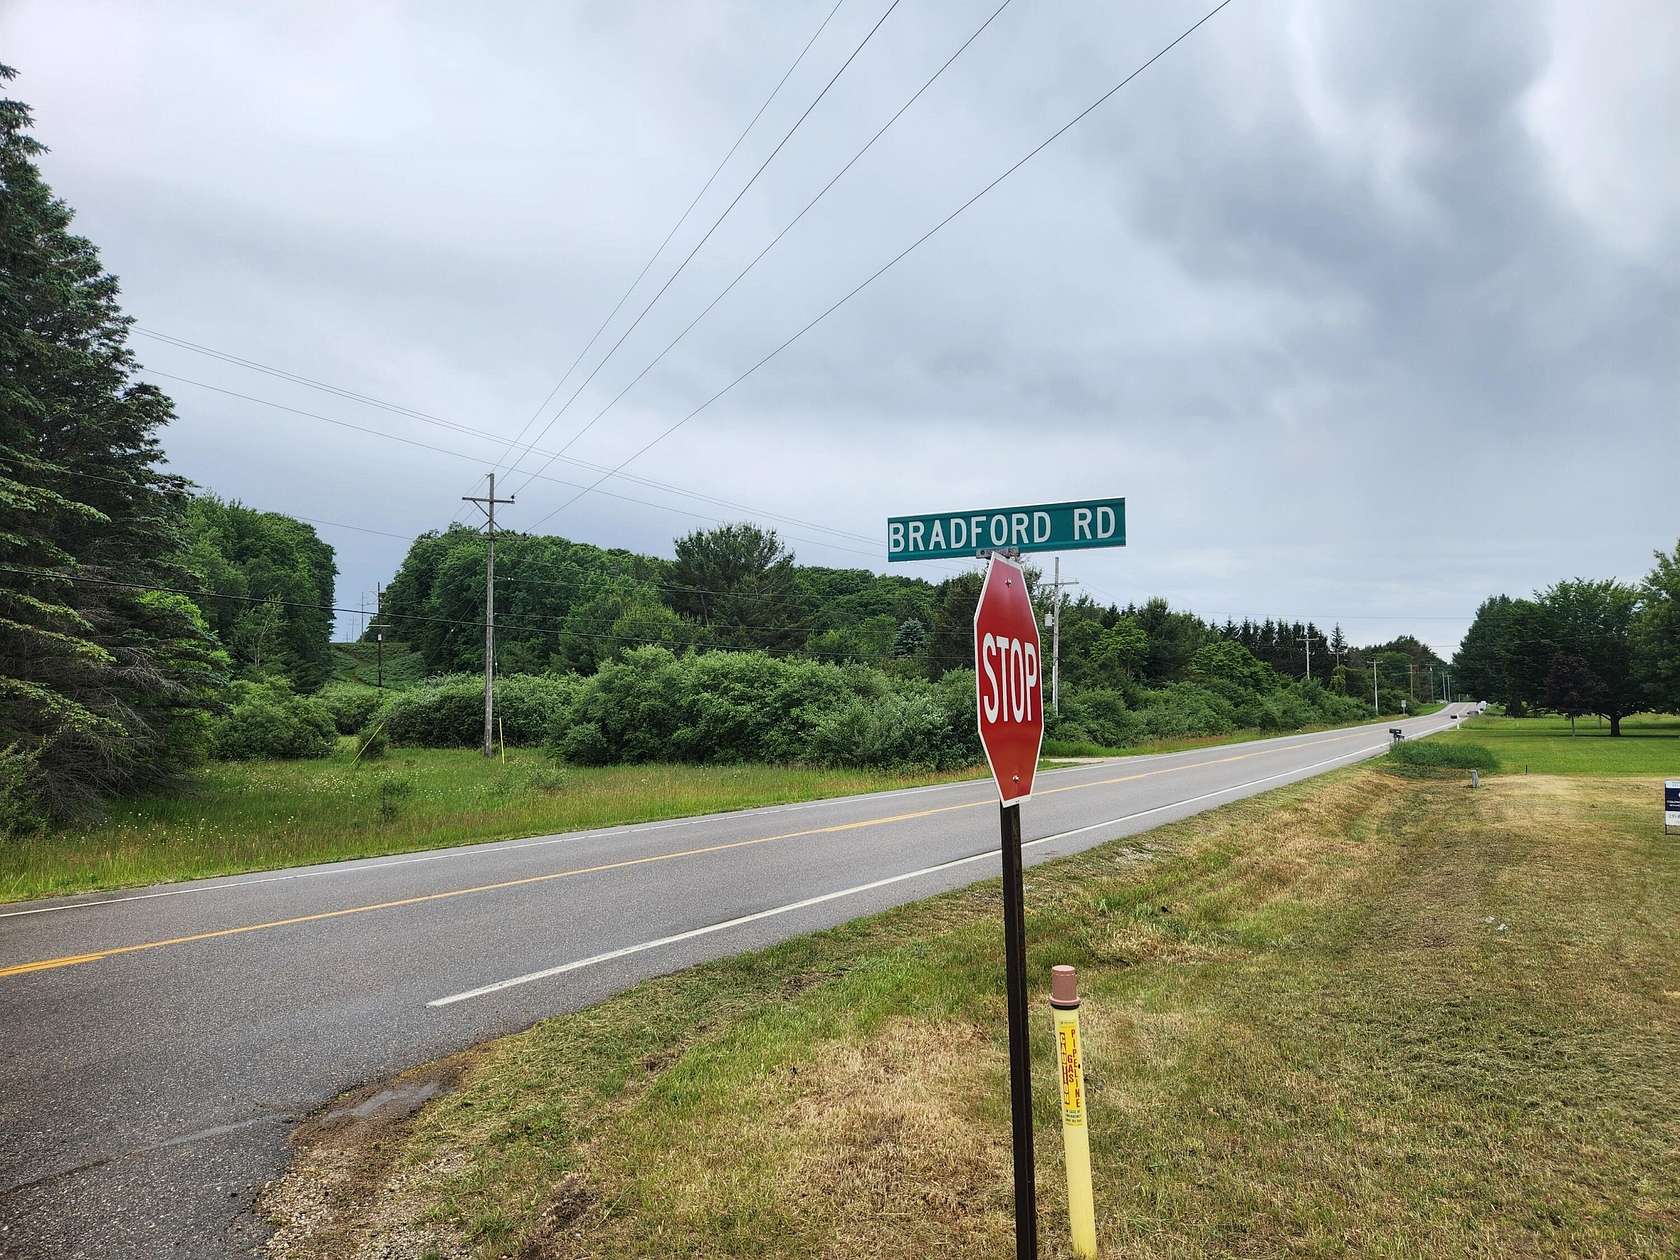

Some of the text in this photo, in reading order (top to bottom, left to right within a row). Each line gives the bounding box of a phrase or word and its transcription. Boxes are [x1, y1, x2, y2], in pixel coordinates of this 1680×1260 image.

[889, 506, 1116, 553] BRADFORD RD
[982, 632, 1037, 724] STOP
[1071, 1029, 1080, 1108] PIPELINE
